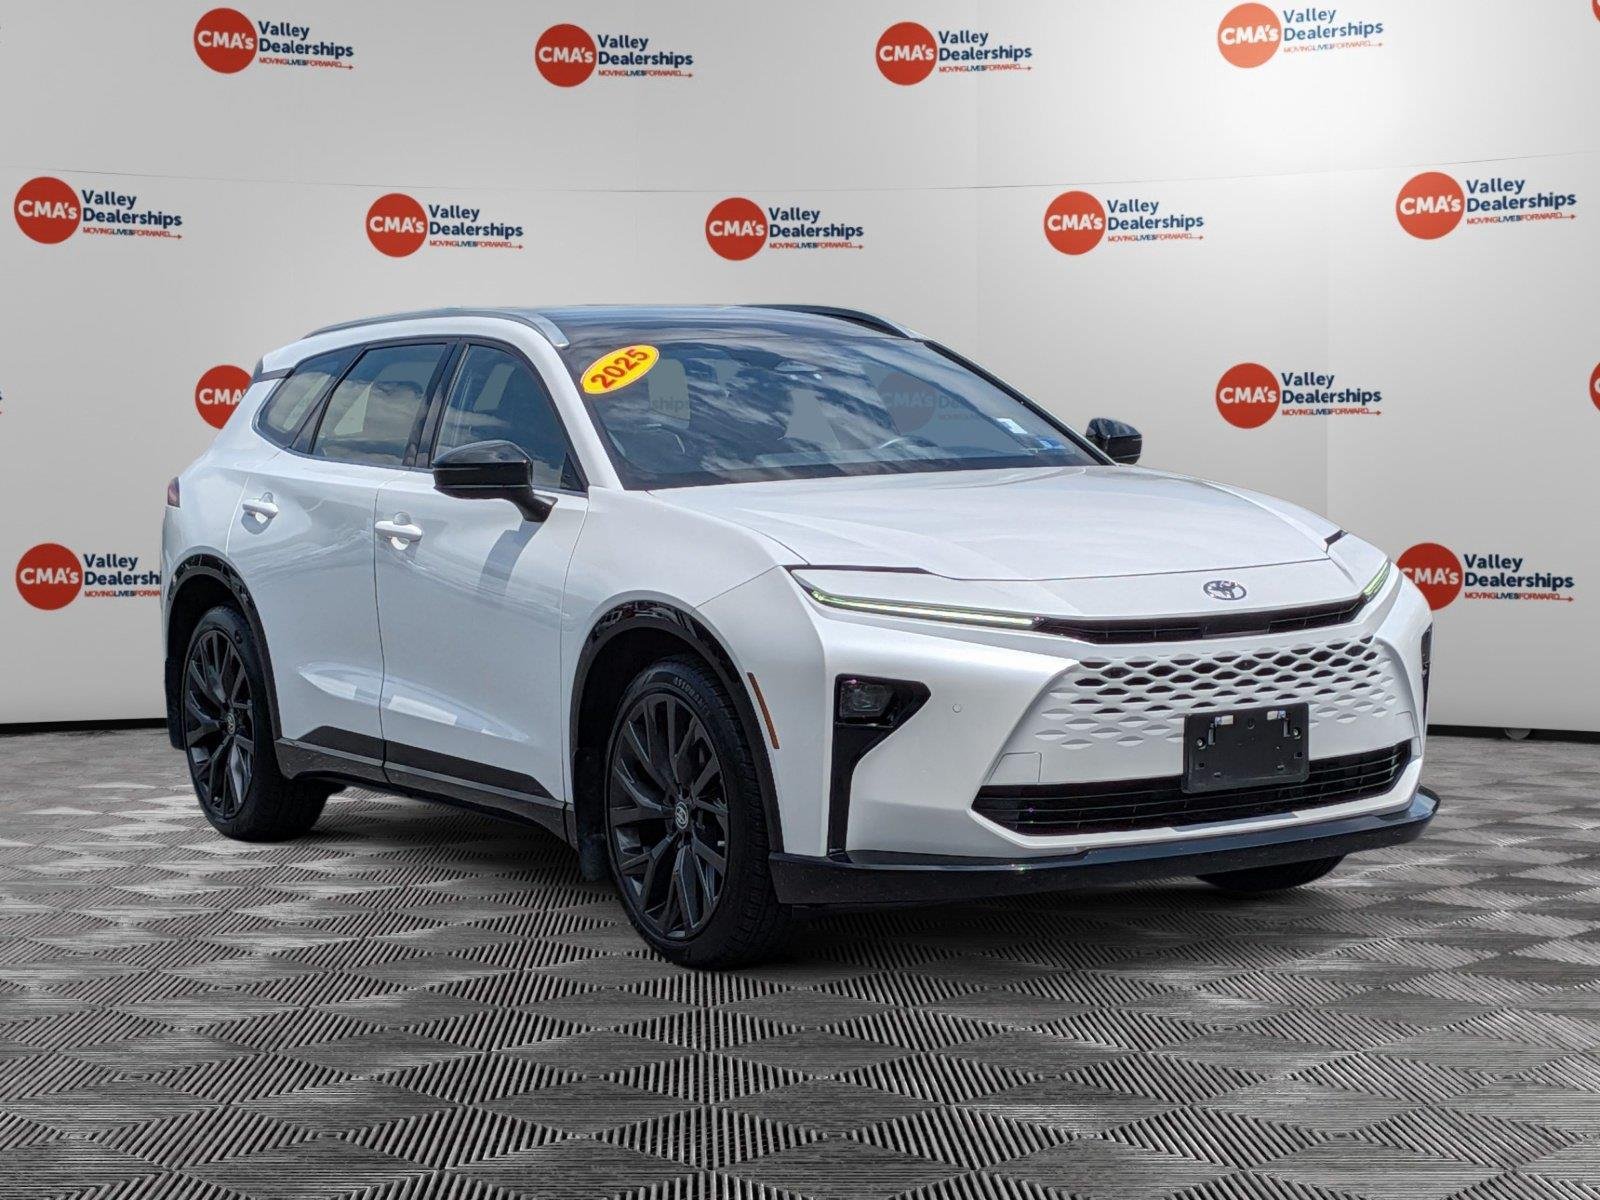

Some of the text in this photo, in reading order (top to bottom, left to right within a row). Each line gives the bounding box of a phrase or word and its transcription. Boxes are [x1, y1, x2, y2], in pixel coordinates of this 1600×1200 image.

[1283, 8, 1336, 24] Valley
[258, 21, 310, 40] Valley
[938, 31, 989, 46] Valley
[1220, 25, 1279, 45] CMA's
[1284, 21, 1383, 42] Dealerships
[197, 30, 254, 50] CMA's
[259, 39, 353, 59] Dealerships
[598, 34, 649, 51] Valley
[538, 47, 593, 63] CMA's
[598, 52, 693, 68] Dealerships
[879, 45, 934, 61] CMA's
[939, 45, 1032, 62] Dealerships
[1466, 178, 1525, 195] Valley
[82, 190, 137, 209] Valley
[1107, 199, 1159, 215] Valley
[1400, 194, 1462, 215] CMA's
[1467, 192, 1576, 213] Dealerships
[18, 199, 77, 220] CMA's
[82, 207, 182, 229] Dealerships
[429, 204, 480, 222] Valley
[769, 207, 820, 224] Valley
[369, 216, 424, 233] CMA's
[429, 222, 523, 240] Dealerships
[709, 220, 764, 237] CMA's
[1047, 213, 1103, 231] CMA's
[1108, 214, 1204, 231] Dealerships
[769, 223, 863, 240] Dealerships
[591, 349, 648, 389] 2025
[1281, 371, 1335, 389] Valley
[1218, 386, 1277, 405] CMA's
[1282, 388, 1382, 407] Dealerships
[83, 553, 138, 571] Valley
[1464, 553, 1523, 572] Valley
[20, 567, 79, 585] CMA's
[84, 570, 162, 586] Dealershi
[1401, 567, 1459, 585] MA's
[1464, 571, 1574, 592] Dealerships
